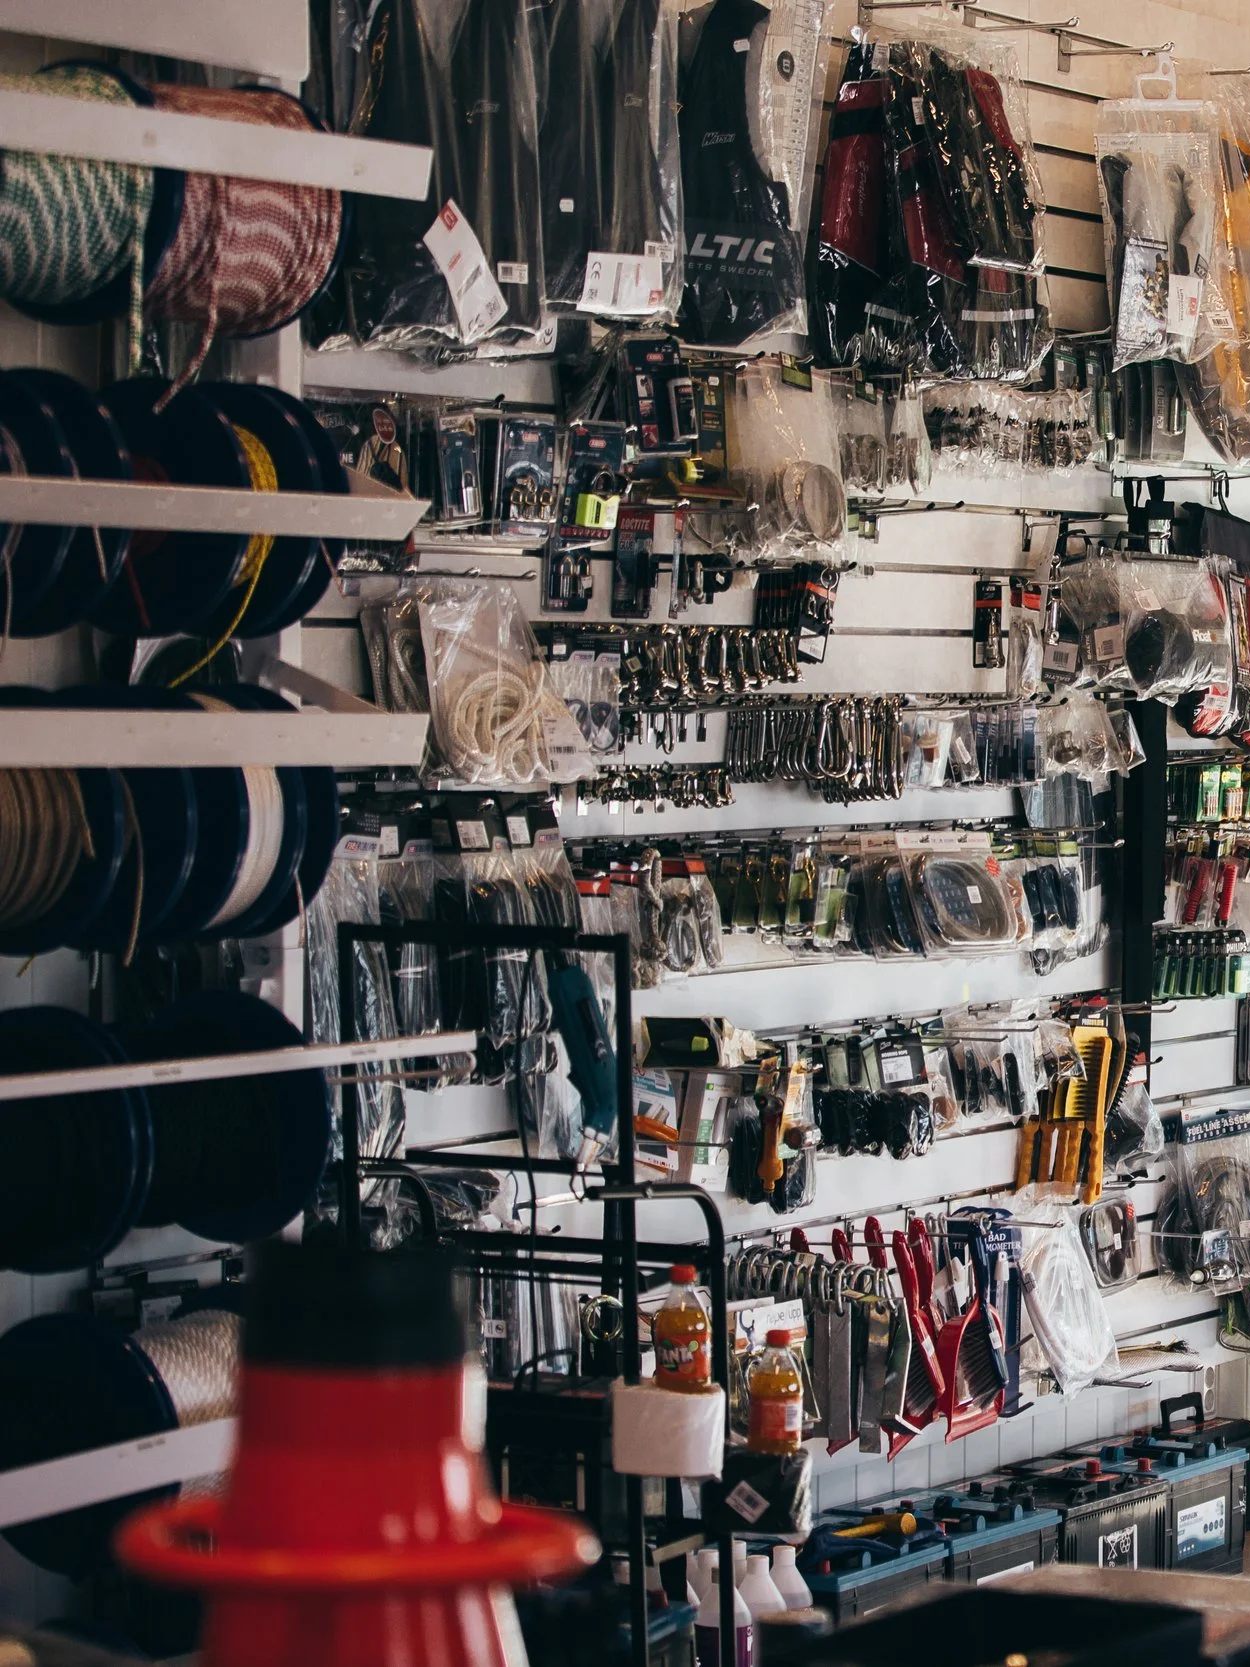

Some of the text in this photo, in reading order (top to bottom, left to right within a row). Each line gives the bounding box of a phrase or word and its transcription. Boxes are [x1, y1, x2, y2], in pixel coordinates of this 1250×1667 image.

[719, 264, 774, 277] SWEDEN
[1226, 941, 1247, 954] PHILIPS
[1187, 1123, 1204, 1137] FUEL
[1204, 1119, 1221, 1131] LINE
[987, 1233, 1007, 1243] BAD
